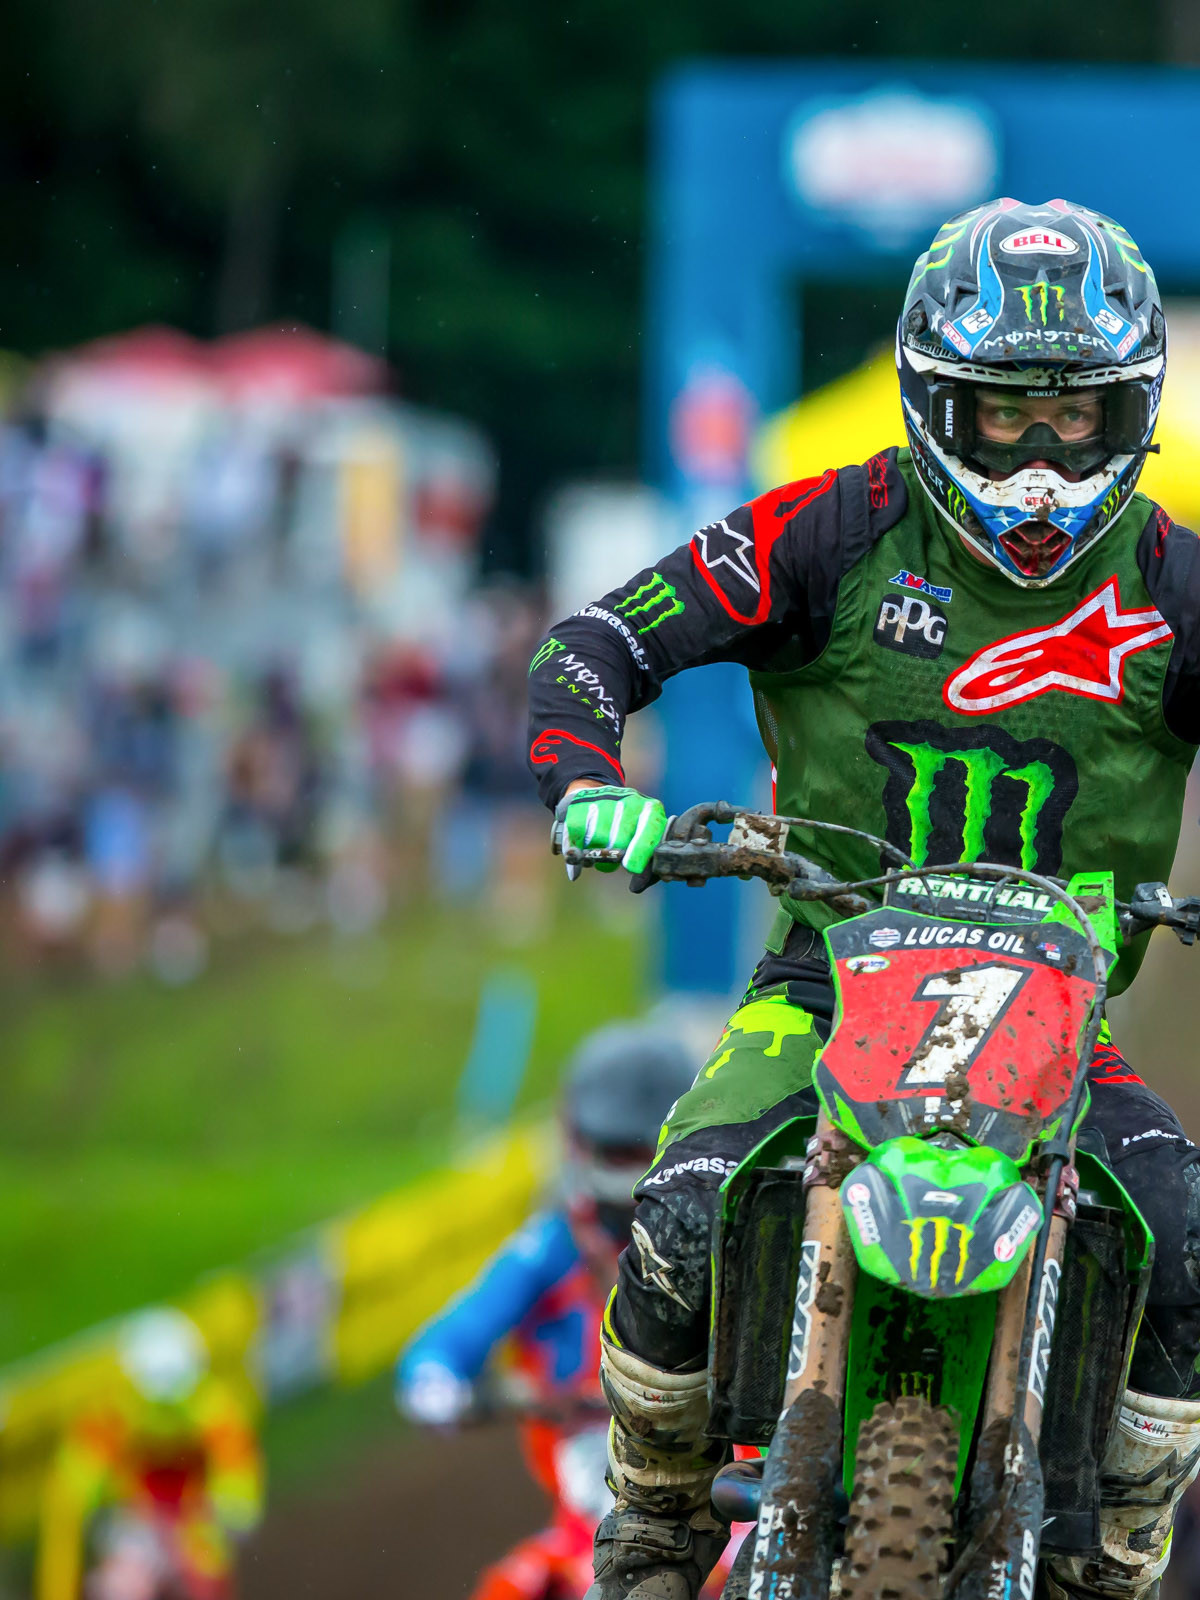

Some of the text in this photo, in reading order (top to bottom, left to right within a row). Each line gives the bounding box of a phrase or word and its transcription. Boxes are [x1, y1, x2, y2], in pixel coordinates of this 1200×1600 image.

[1012, 233, 1068, 250] BELL
[1026, 389, 1060, 398] OAKLEY
[944, 398, 954, 439] OAKLEY
[876, 595, 949, 646] PPG
[896, 876, 1056, 913] RENTHAL
[903, 926, 985, 946] LUCAS
[987, 931, 1025, 954] OIL
